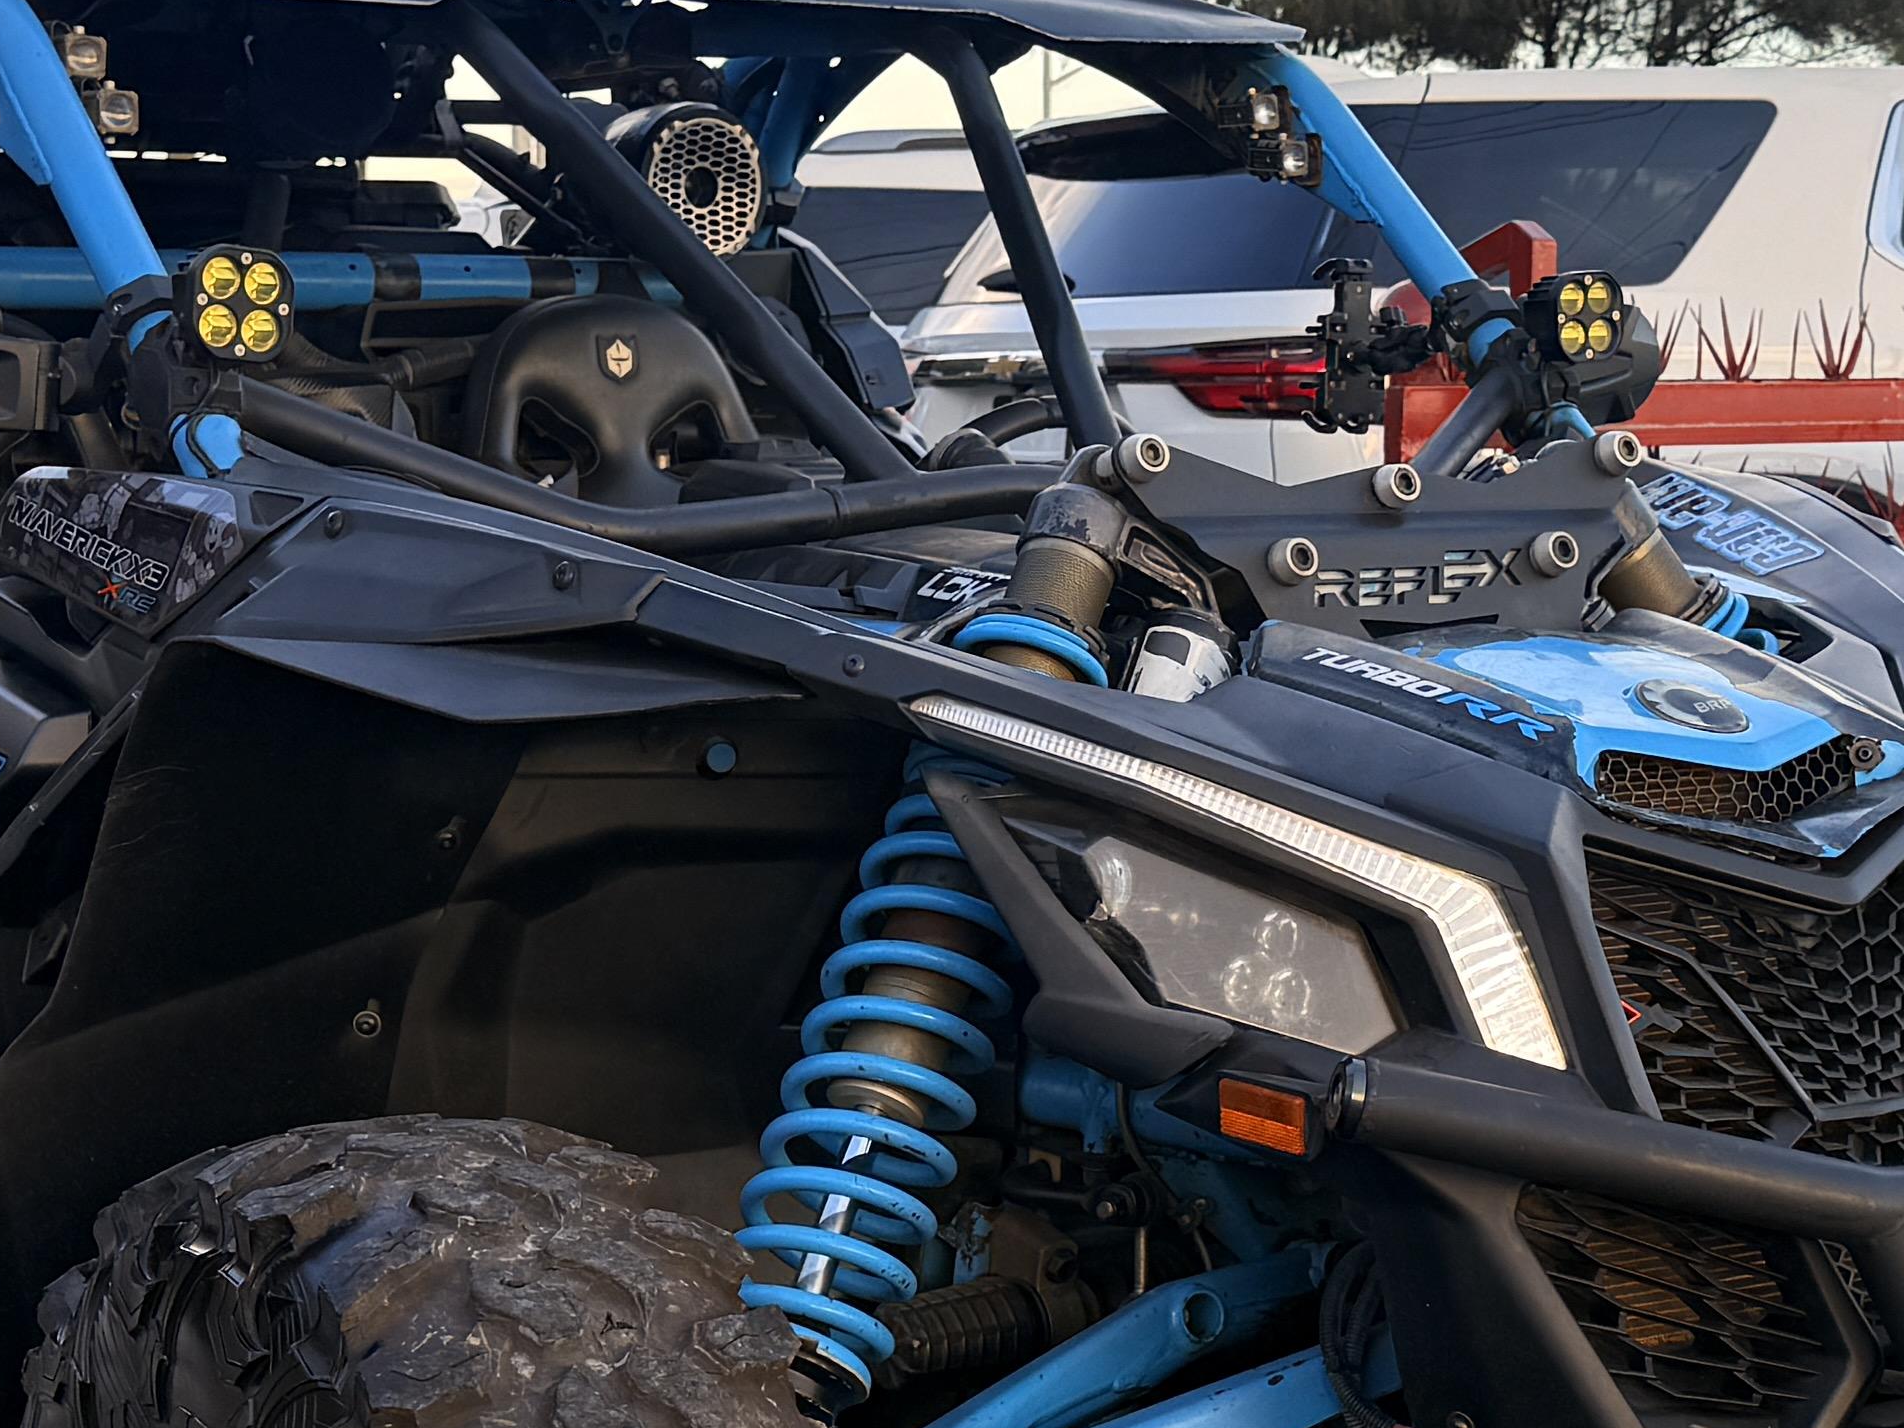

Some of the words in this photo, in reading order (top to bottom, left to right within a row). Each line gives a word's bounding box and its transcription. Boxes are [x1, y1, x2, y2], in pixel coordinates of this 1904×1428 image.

[9, 495, 132, 578] MAVERICK
[1313, 548, 1521, 607] REFLEX
[1302, 647, 1453, 698] TURBO
